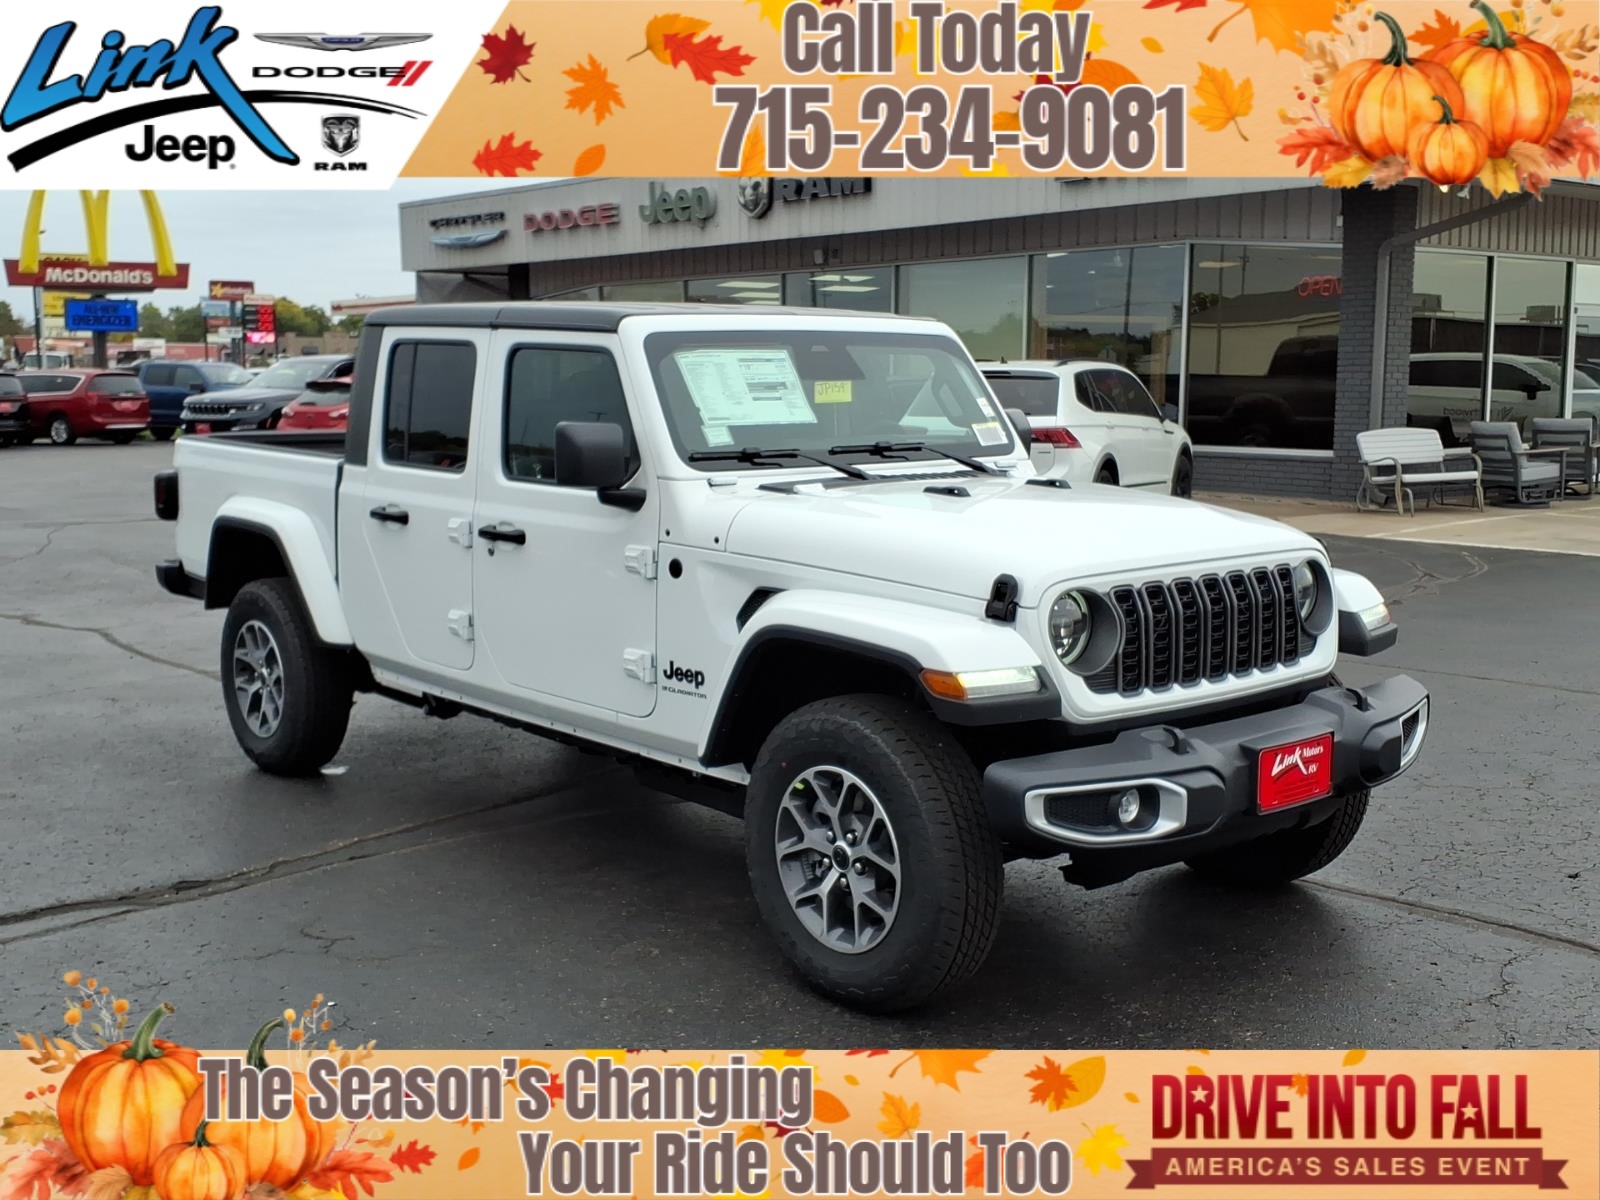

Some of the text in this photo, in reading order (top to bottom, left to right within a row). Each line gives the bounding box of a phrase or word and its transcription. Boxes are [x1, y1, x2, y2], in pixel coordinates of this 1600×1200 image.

[772, 177, 872, 202] RAM
[523, 203, 620, 232] DODGE
[639, 182, 717, 229] Jeep
[45, 267, 153, 284] McDonald's
[1298, 275, 1342, 297] OPEN
[663, 660, 705, 690] Jeep
[1271, 746, 1308, 777] Link
